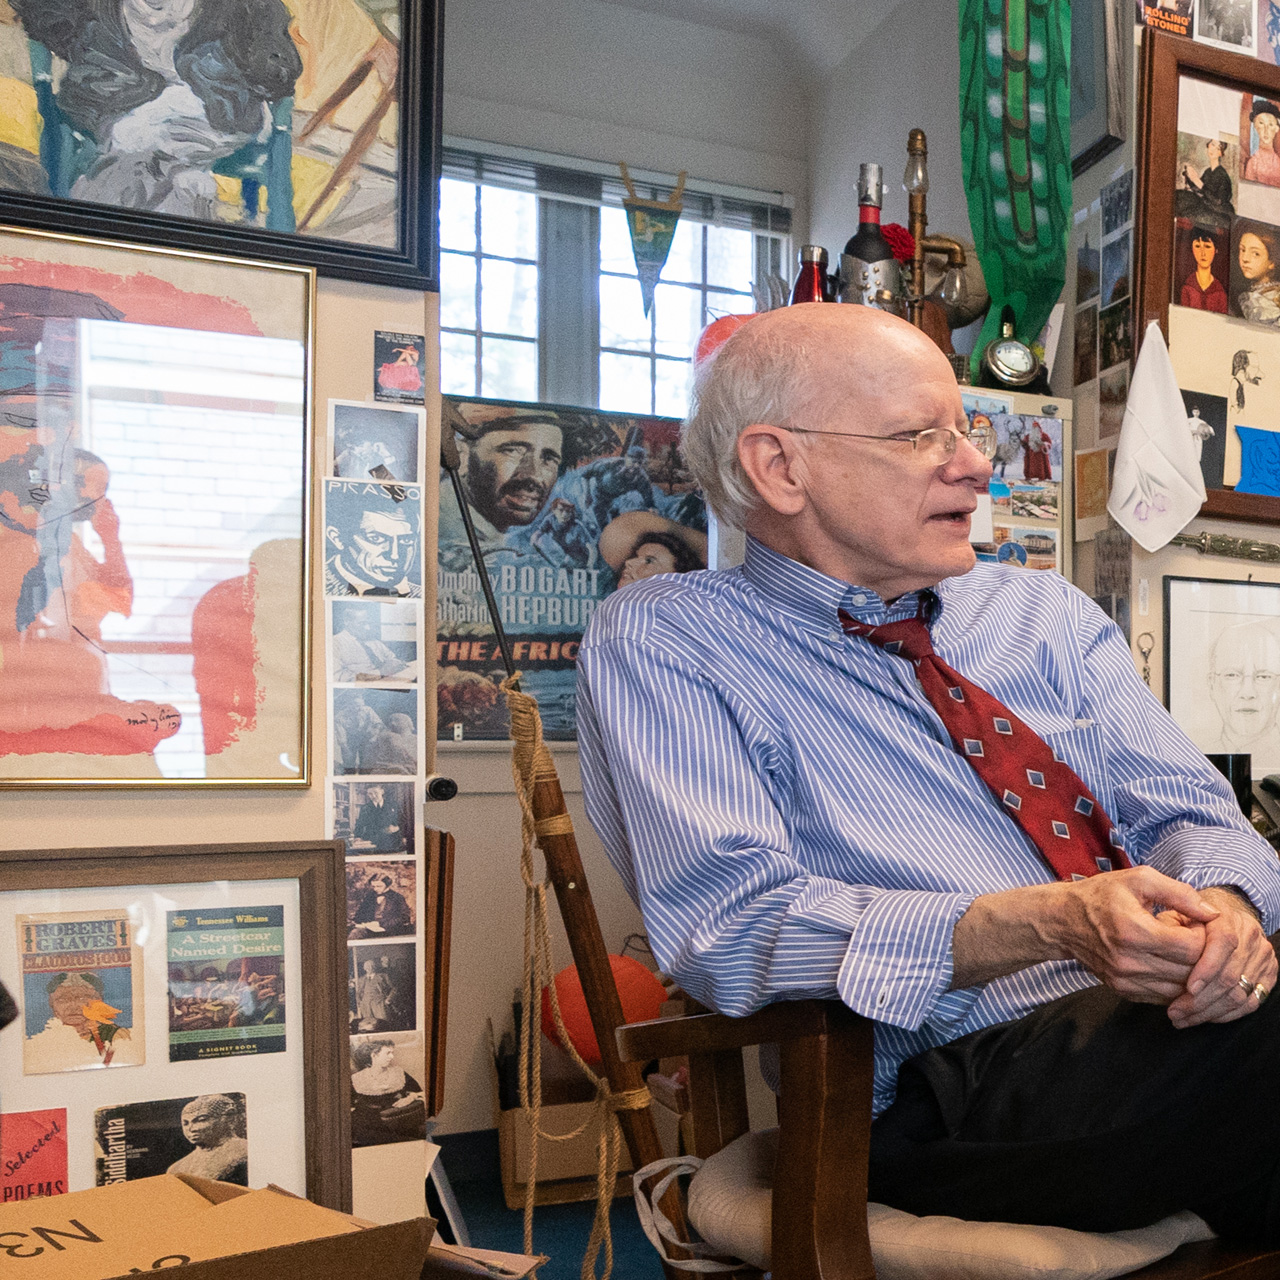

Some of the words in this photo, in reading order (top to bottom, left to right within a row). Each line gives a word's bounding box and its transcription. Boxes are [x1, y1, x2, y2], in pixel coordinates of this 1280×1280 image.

[1147, 17, 1187, 35] STONES
[328, 481, 420, 500] PICASSO
[501, 565, 600, 596] BOGART
[437, 641, 488, 661] THE
[490, 641, 581, 661] AFRIC
[35, 920, 117, 938] ROBERT
[196, 917, 234, 926] Tennessee
[235, 914, 269, 923] Williams
[36, 934, 117, 952] GRAVES
[182, 934, 196, 944] A
[200, 932, 272, 944] Streetcar
[171, 945, 227, 957] Named
[232, 942, 282, 955] Desire
[206, 1045, 233, 1053] SIGNET
[235, 1043, 257, 1051] BOOK
[4, 1120, 62, 1178] Selected
[103, 1117, 127, 1186] Siddhartha
[4, 1179, 64, 1202] POEMS
